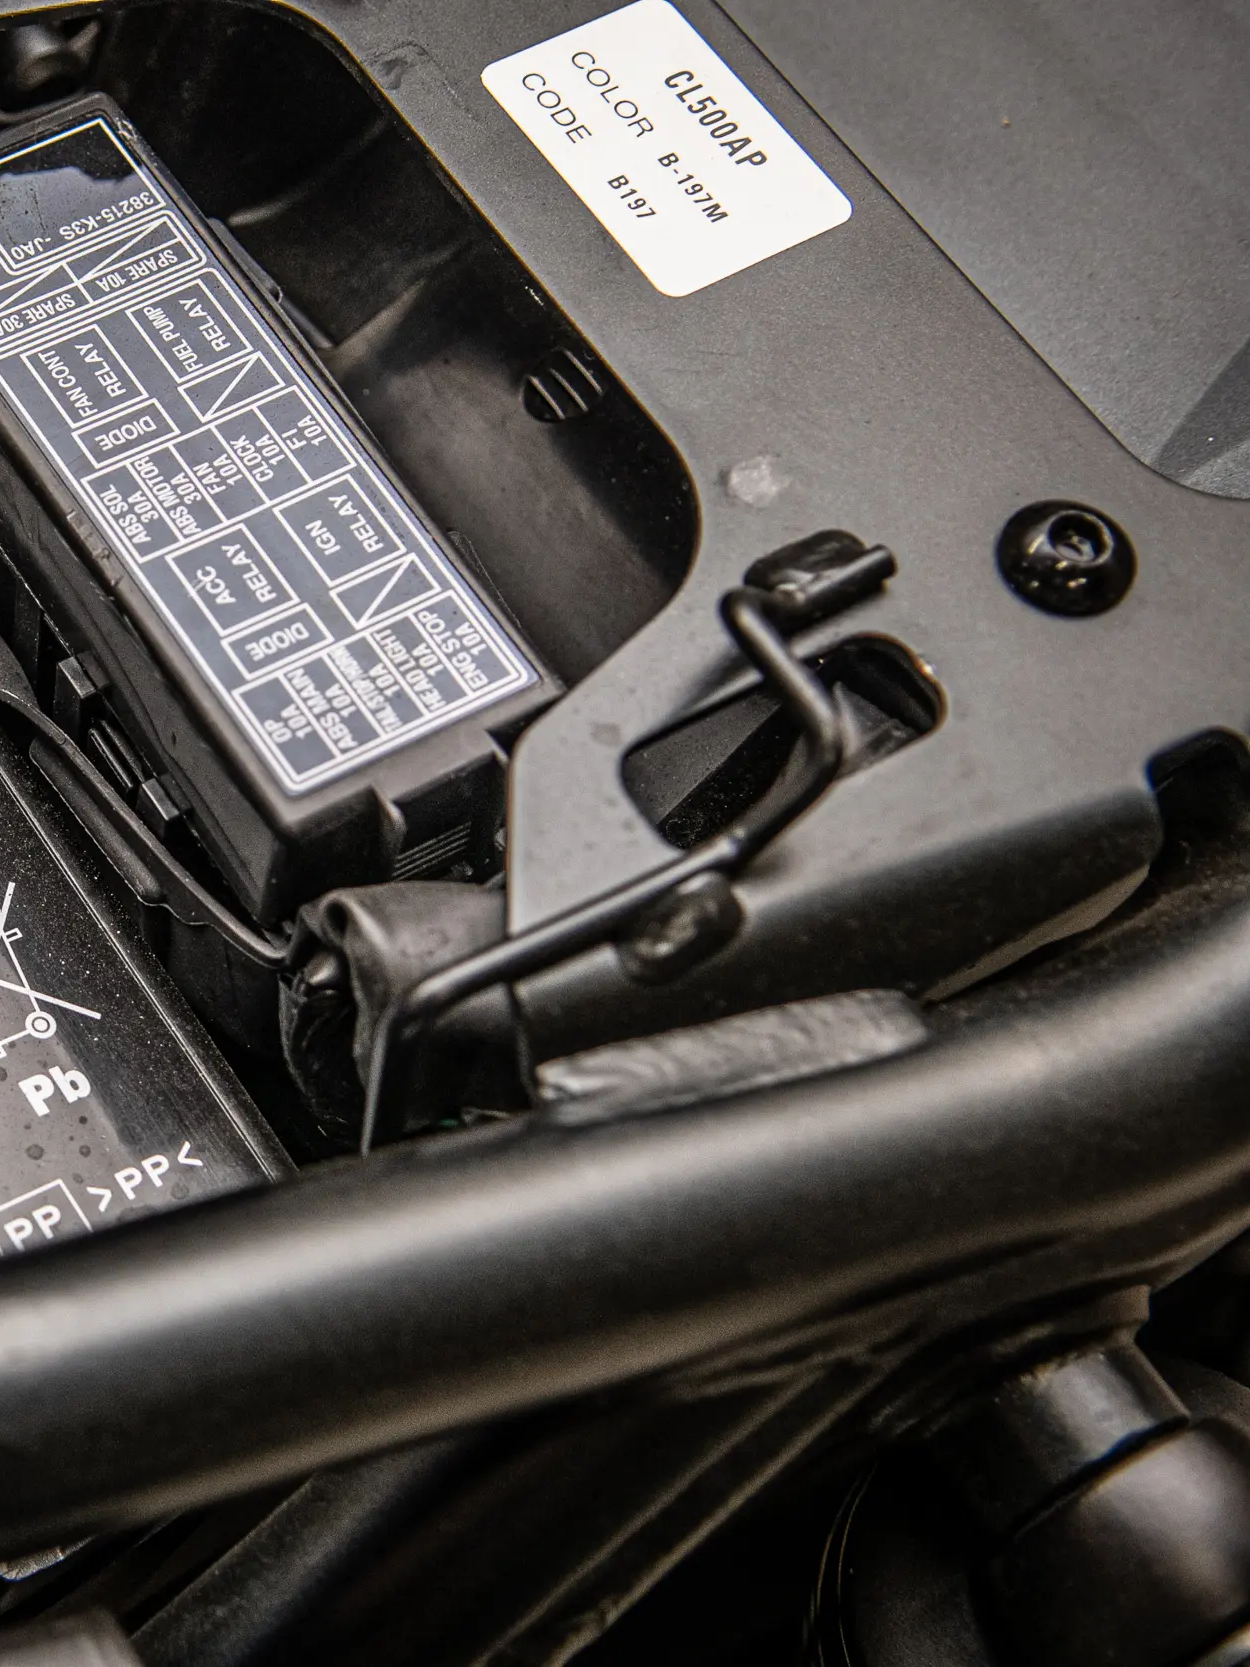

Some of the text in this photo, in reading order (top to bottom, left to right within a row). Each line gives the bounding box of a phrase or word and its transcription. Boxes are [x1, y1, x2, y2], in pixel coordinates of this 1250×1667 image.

[571, 51, 729, 223] COLOR B-197M
[664, 70, 768, 168] CL500AP
[522, 72, 657, 220] CODE B197
[10, 191, 160, 260] 38215-K3S -JA0
[95, 249, 178, 292] SPARE 10A
[21, 293, 76, 324] SPARE
[178, 298, 231, 352] RELAY
[143, 306, 204, 373] FUEL PUMP
[37, 350, 98, 418] FAN CONT
[74, 343, 127, 398] RELAY
[94, 415, 157, 451] DIODE
[255, 433, 286, 466] 10A
[297, 414, 327, 446] 10A
[192, 462, 227, 495] FAN
[212, 453, 243, 486] 10A
[229, 434, 274, 483] CLOCK
[127, 490, 159, 523] 30A
[133, 456, 202, 535] ABS MOTOR
[170, 472, 202, 505] 30A
[99, 484, 151, 544] ABS SOL
[328, 494, 384, 553] RELAY
[305, 519, 341, 556] IGN
[196, 565, 237, 605] ACC
[221, 543, 277, 603] RELAY
[245, 622, 310, 661] DIODE
[411, 642, 444, 676] 10A
[418, 610, 489, 689] ENG STOP
[454, 621, 487, 656] 10A
[368, 662, 400, 697] 10A
[370, 629, 446, 714] HEAD LIGHT
[280, 703, 313, 738] 10A
[287, 668, 358, 755] ABS MAIN
[324, 683, 357, 717] 10A
[18, 1065, 91, 1117] Pb
